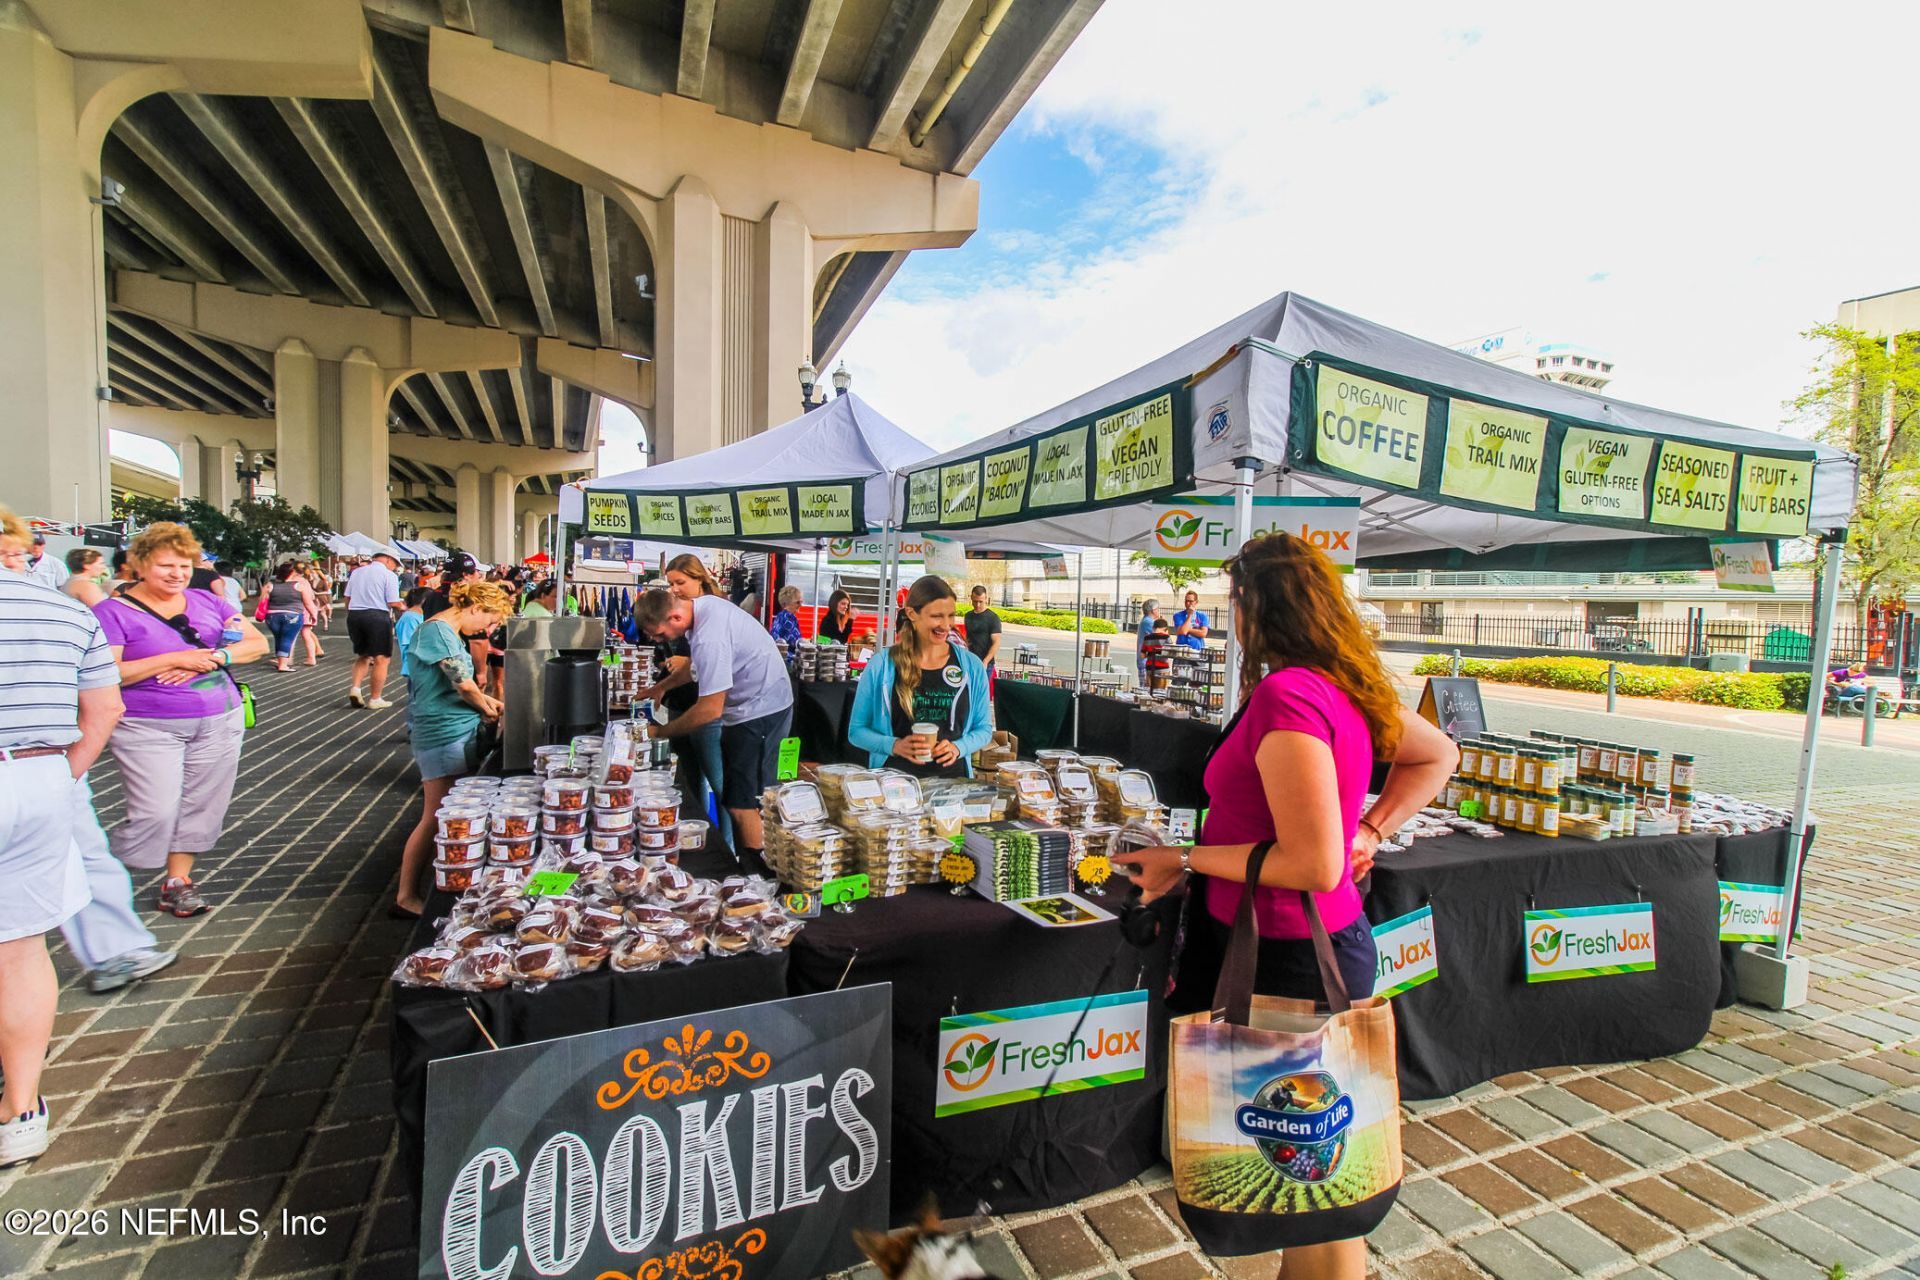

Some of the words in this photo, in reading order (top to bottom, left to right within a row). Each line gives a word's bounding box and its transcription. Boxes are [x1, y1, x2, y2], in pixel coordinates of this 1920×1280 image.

[1337, 382, 1407, 415] ORGANIC
[1100, 398, 1169, 436] GLUTEN-FREE
[1323, 410, 1419, 463] COFFEE
[1481, 422, 1531, 444] ORGANIC
[1046, 444, 1070, 461] LOCAL
[1111, 438, 1158, 466] VEGAN
[1588, 439, 1629, 457] VEGAN
[987, 453, 1028, 478] COCONUT
[1468, 445, 1504, 468] TRAIL
[1510, 454, 1537, 474] MIX
[1597, 460, 1610, 468] AND
[1661, 453, 1729, 479] SEASONED
[945, 470, 976, 488] ORGANIC
[1034, 468, 1054, 485] MADE
[1056, 468, 1065, 480] IN
[1066, 464, 1083, 481] JAX
[1108, 458, 1162, 484] FRIENDLY
[1565, 470, 1638, 492] GLUTEN-FREE
[1750, 466, 1787, 486] FRUIT
[1789, 473, 1798, 485] +
[590, 497, 628, 509] PUMPKIN
[651, 500, 674, 509] ORGANIC
[754, 495, 781, 504] ORGANIC
[812, 493, 838, 504] LOCAL
[911, 500, 937, 516] COOKIES
[943, 495, 976, 515] QUINOA
[1581, 495, 1620, 509] OPTIONS
[1656, 486, 1681, 506] SEA
[1684, 490, 1726, 512] SALTS
[1740, 494, 1766, 512] NUT
[1769, 497, 1805, 516] BARS
[594, 513, 626, 528] SEEDS
[653, 511, 675, 522] SPICES
[690, 516, 713, 526] ENERGY
[714, 515, 732, 524] BARS
[751, 507, 772, 518] TRAIL
[773, 506, 789, 517] MIX
[801, 508, 824, 519] MADE
[826, 508, 834, 518] IN
[835, 508, 850, 518] JAX
[1564, 928, 1650, 957] FreshJax
[1001, 1028, 1141, 1075] FreshJax
[1242, 1111, 1311, 1135] Garden
[1315, 1111, 1332, 1139] of
[1331, 1103, 1349, 1126] Life
[442, 1067, 879, 1280] COOKIES
